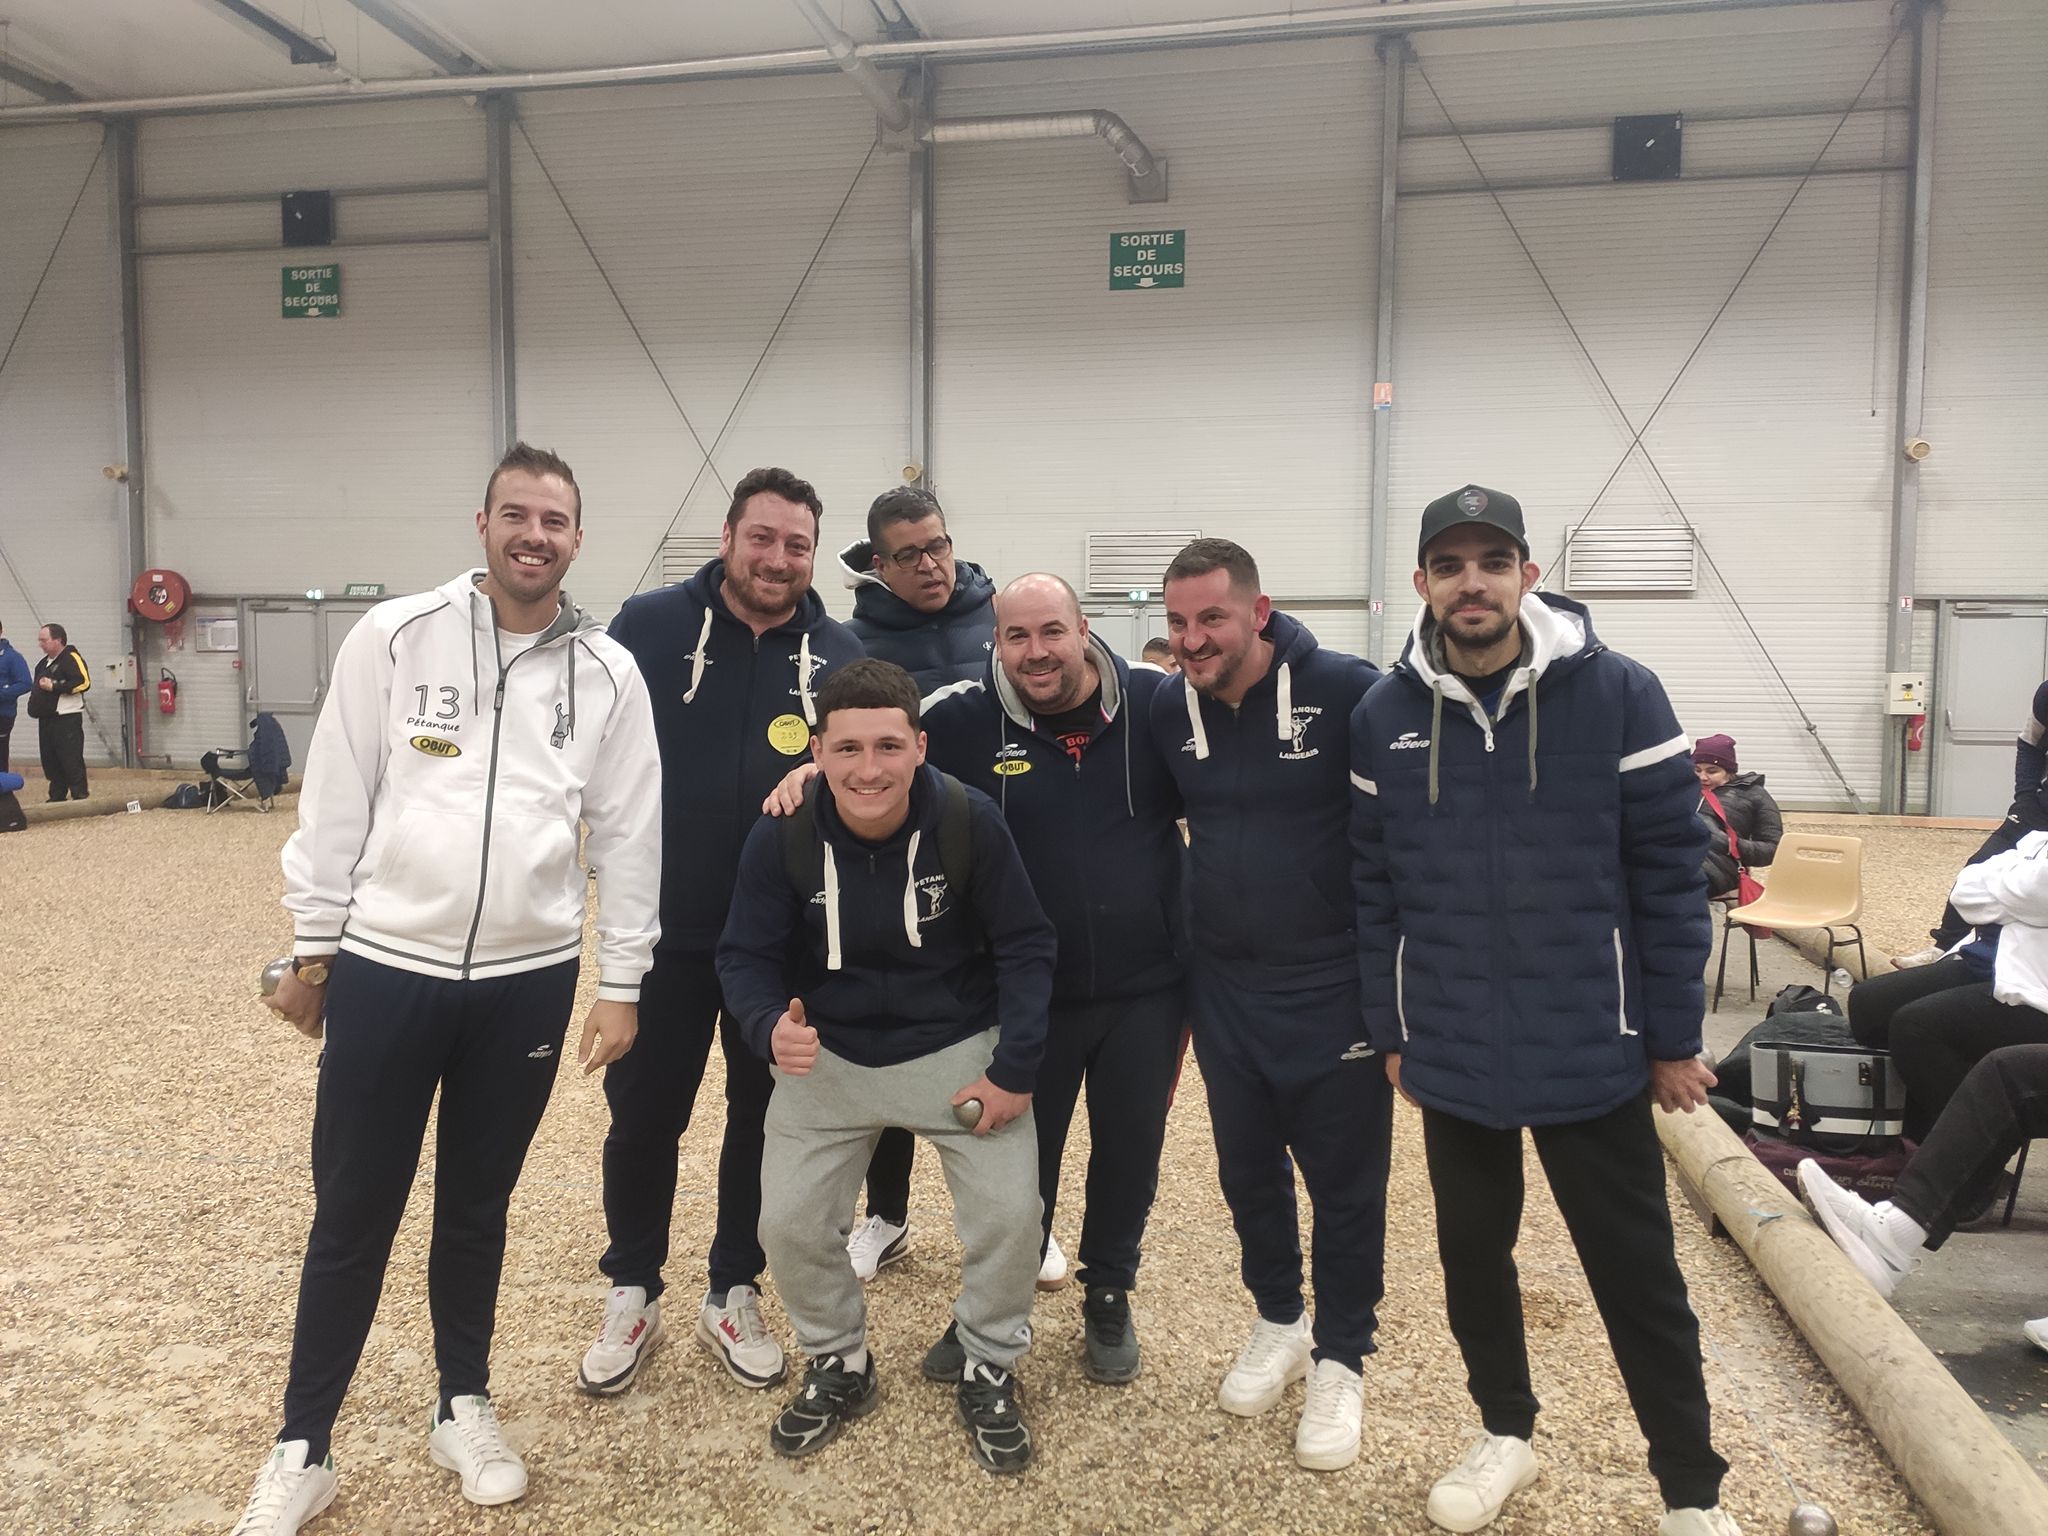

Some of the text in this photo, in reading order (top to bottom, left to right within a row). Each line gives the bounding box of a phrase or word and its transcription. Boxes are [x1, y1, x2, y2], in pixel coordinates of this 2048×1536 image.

[1120, 233, 1175, 247] SORTIE
[1136, 249, 1157, 261] DE
[291, 268, 333, 280] SORTIE
[1113, 263, 1183, 277] SECOURS
[305, 283, 321, 293] DE
[284, 294, 338, 307] SECOURS
[415, 684, 461, 720] 13
[406, 717, 461, 732] Pétanque
[419, 738, 454, 754] OBUT
[1279, 748, 1319, 760] LANGEAIS
[1000, 762, 1025, 772] OBUT
